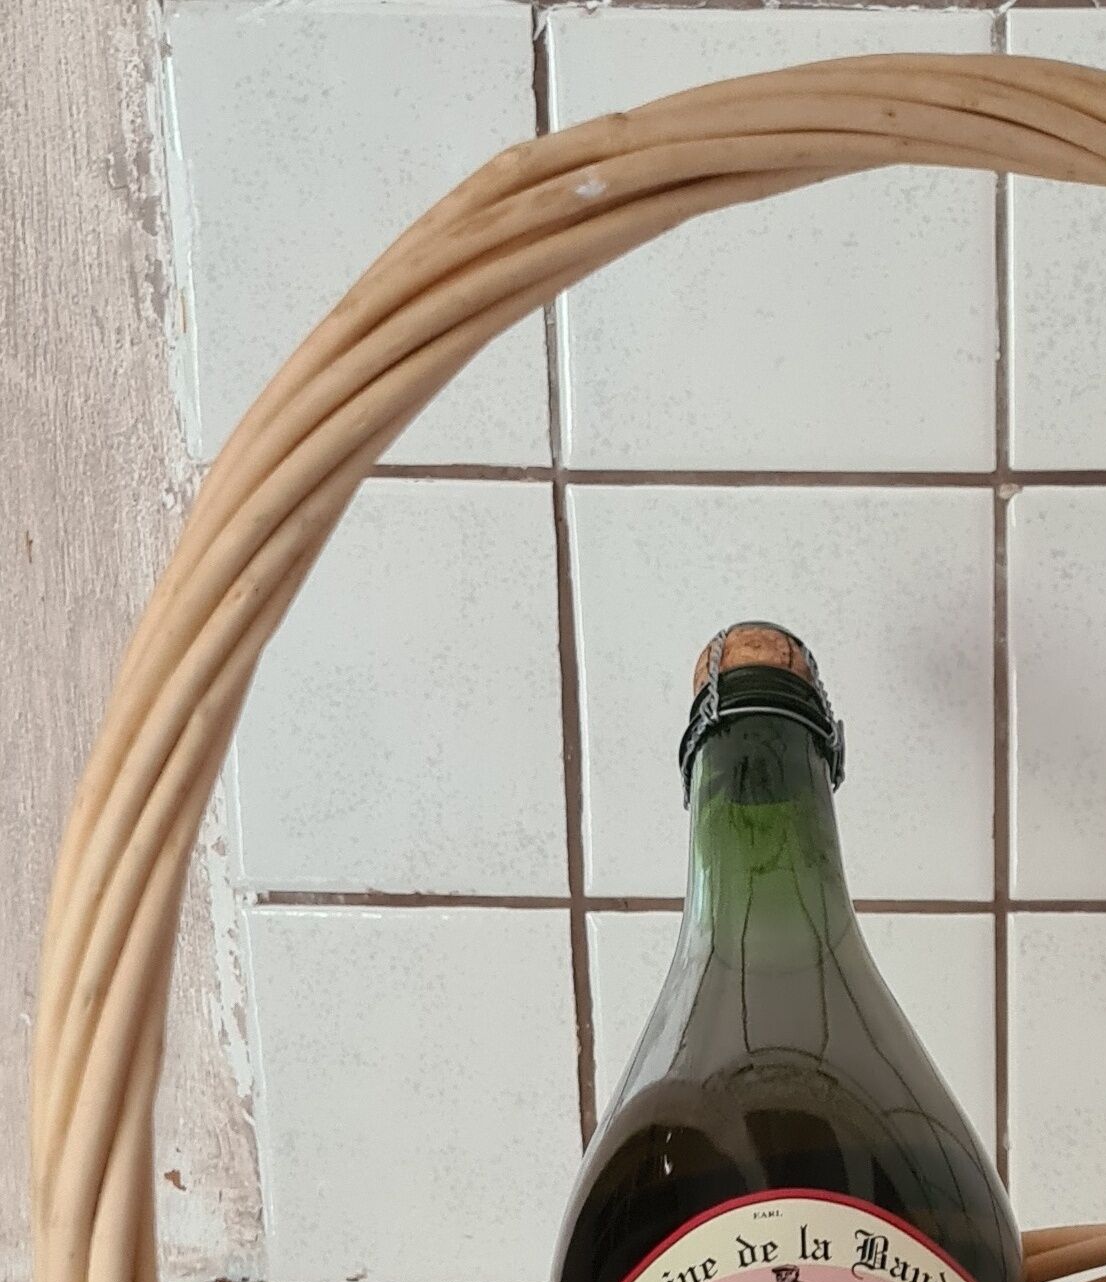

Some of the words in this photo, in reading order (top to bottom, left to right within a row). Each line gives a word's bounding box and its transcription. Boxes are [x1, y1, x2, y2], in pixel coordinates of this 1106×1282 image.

[753, 1210, 783, 1220] EARL
[735, 1234, 779, 1268] de
[799, 1224, 832, 1261] la
